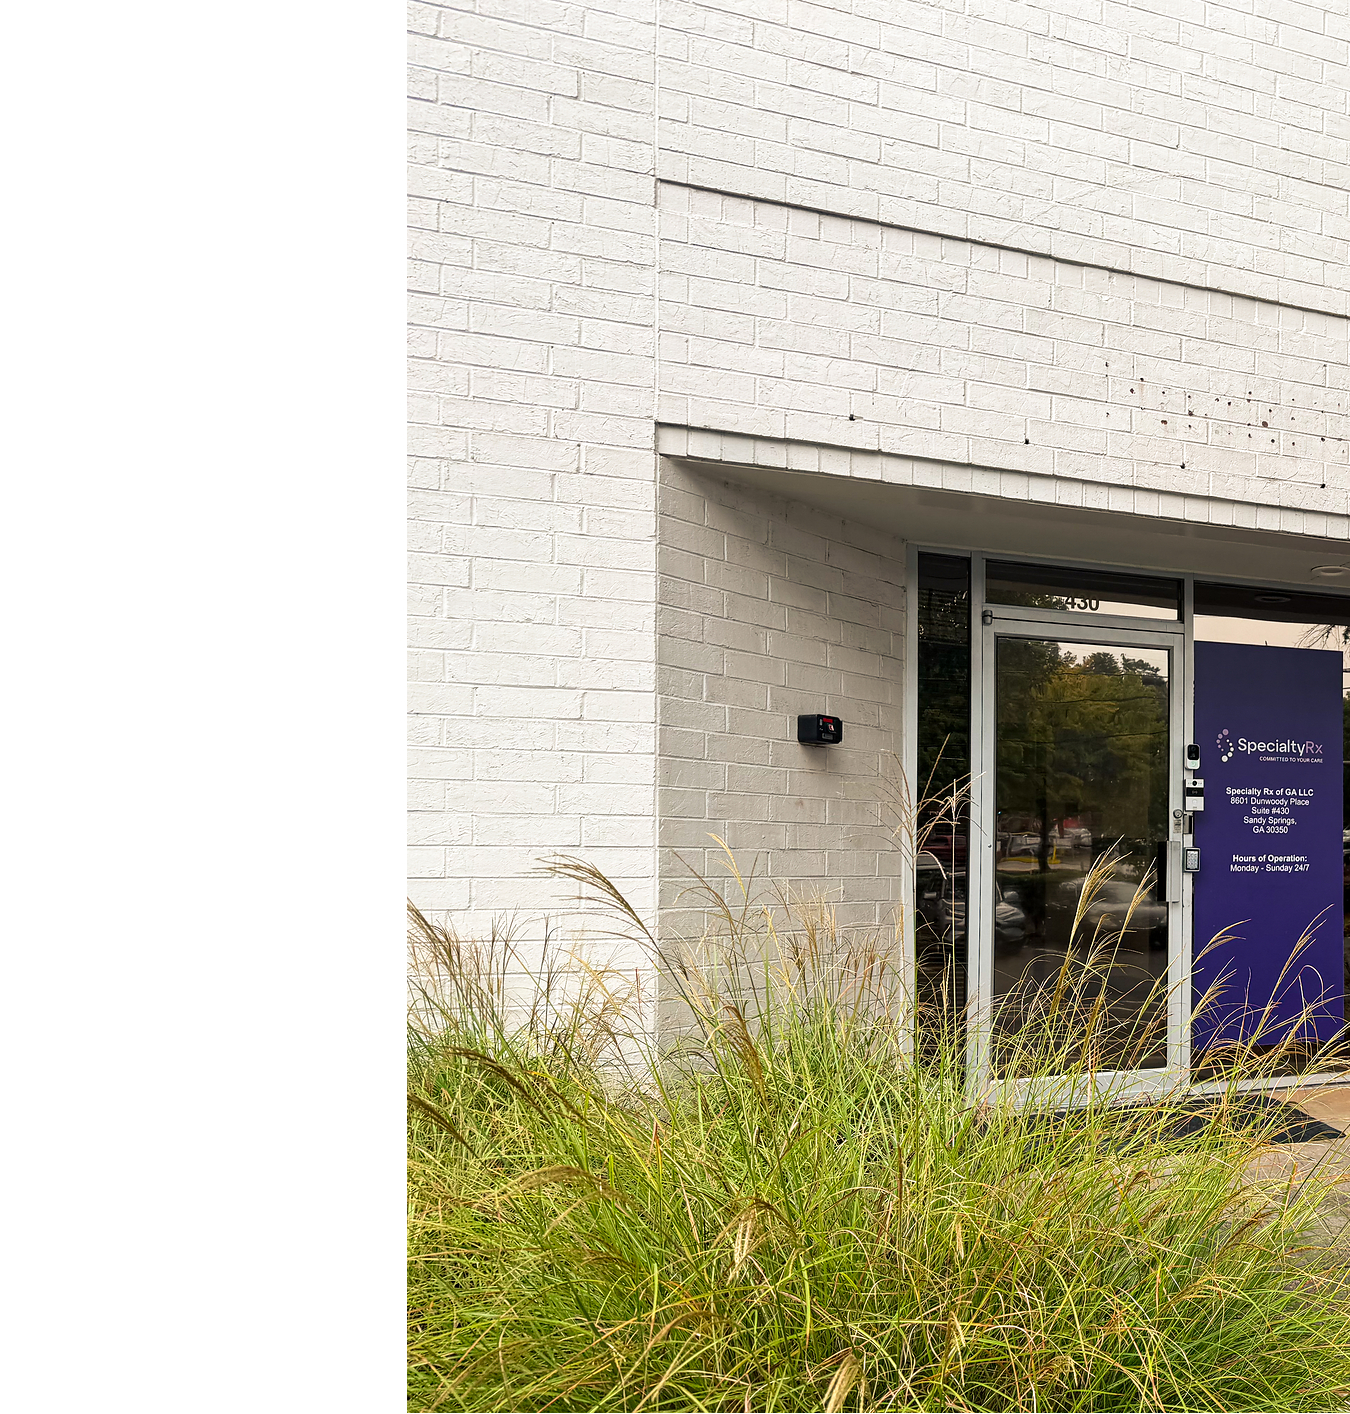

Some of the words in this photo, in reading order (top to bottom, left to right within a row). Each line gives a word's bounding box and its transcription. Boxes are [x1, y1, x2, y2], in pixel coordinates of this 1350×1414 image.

[1065, 593, 1100, 612] 430
[1238, 738, 1323, 756] SpecialtyRx
[1226, 787, 1261, 797] Specialty
[1275, 788, 1283, 796] of
[1285, 788, 1297, 796] GA
[1298, 788, 1314, 796] LLC
[1250, 797, 1288, 806] Dunwoody
[1290, 798, 1310, 806] Place
[1271, 807, 1290, 815] #430
[1243, 816, 1266, 825] Sandy
[1268, 816, 1297, 826] Springs,
[1252, 826, 1265, 834] GA
[1265, 826, 1288, 834] 30350
[1232, 854, 1256, 862] Hours
[1258, 854, 1266, 862] of
[1267, 854, 1308, 863] Operation:
[1230, 864, 1259, 873] Monday
[1265, 864, 1293, 873] Sunday
[1294, 864, 1310, 872] 24/7
